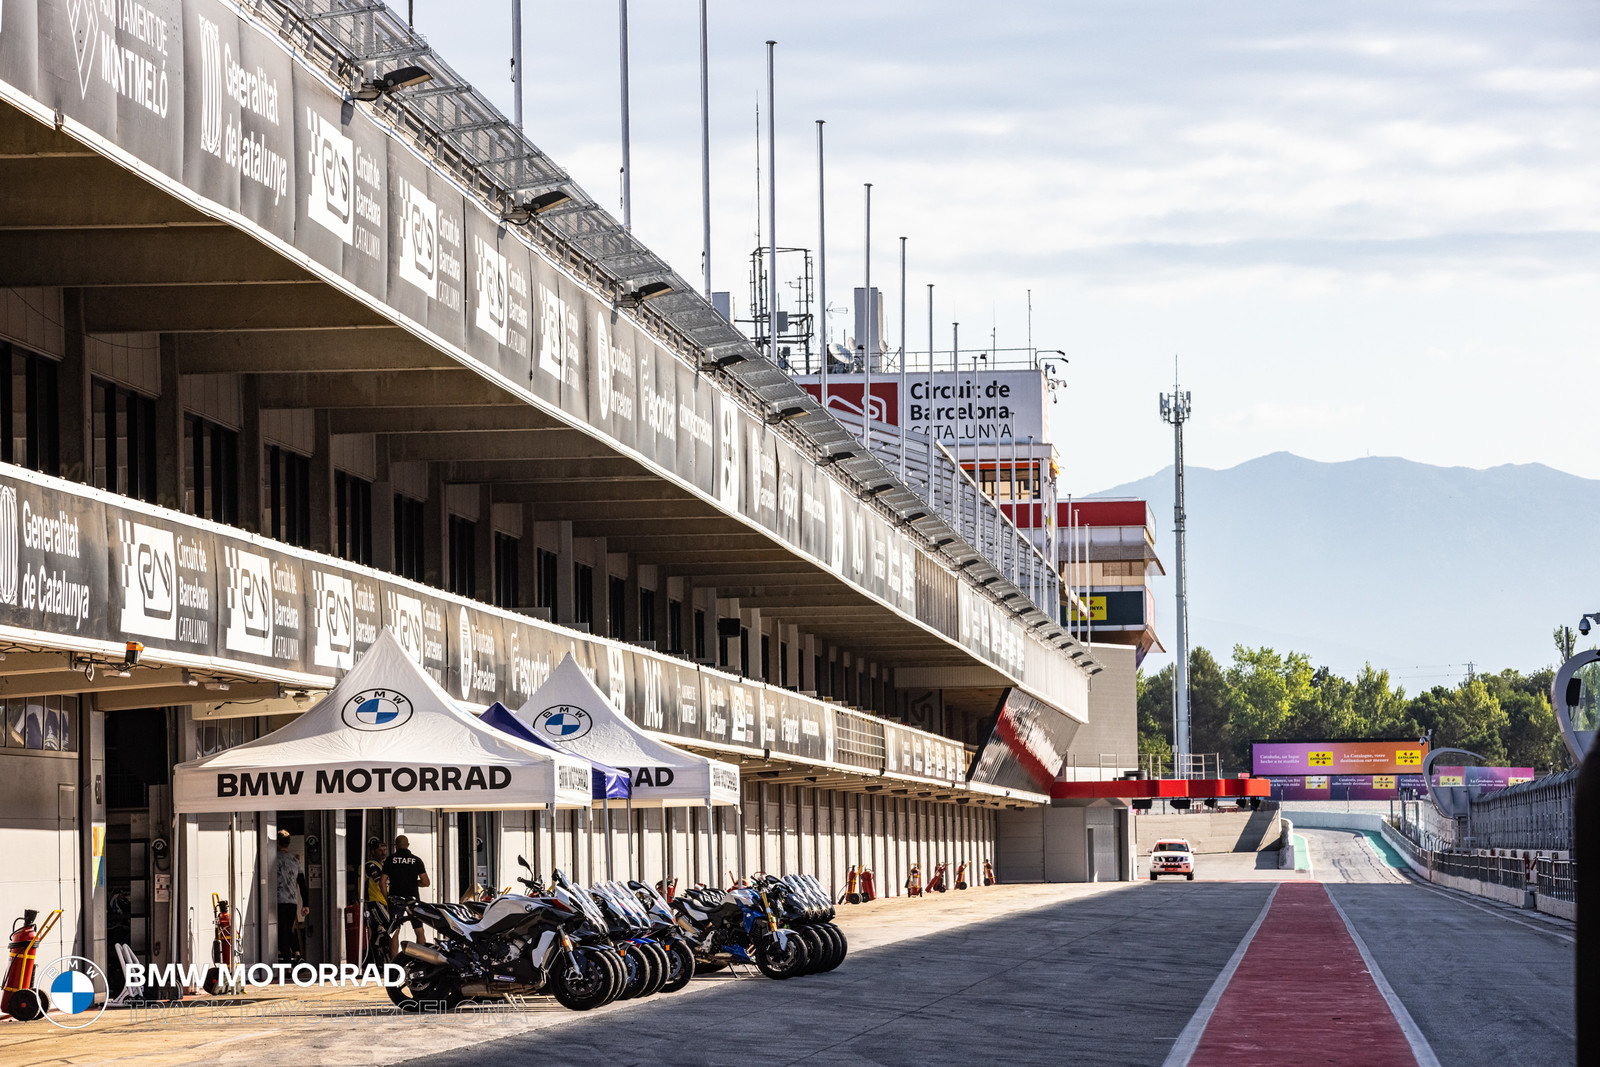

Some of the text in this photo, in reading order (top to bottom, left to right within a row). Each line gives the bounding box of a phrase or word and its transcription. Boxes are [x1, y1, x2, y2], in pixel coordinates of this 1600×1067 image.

[155, 16, 168, 56] DE
[101, 30, 168, 119] MONTMELÓ
[225, 113, 287, 206] de Catalunya
[985, 380, 1010, 398] de
[911, 402, 1010, 420] Barcelona
[23, 500, 80, 558] Generalitat
[177, 535, 199, 571] Circuit
[22, 563, 89, 630] de Catalunya
[179, 576, 209, 610] Barcelona
[354, 690, 405, 704] BMW
[543, 707, 586, 719] BMW
[218, 766, 511, 797] BMW MOTORRAD
